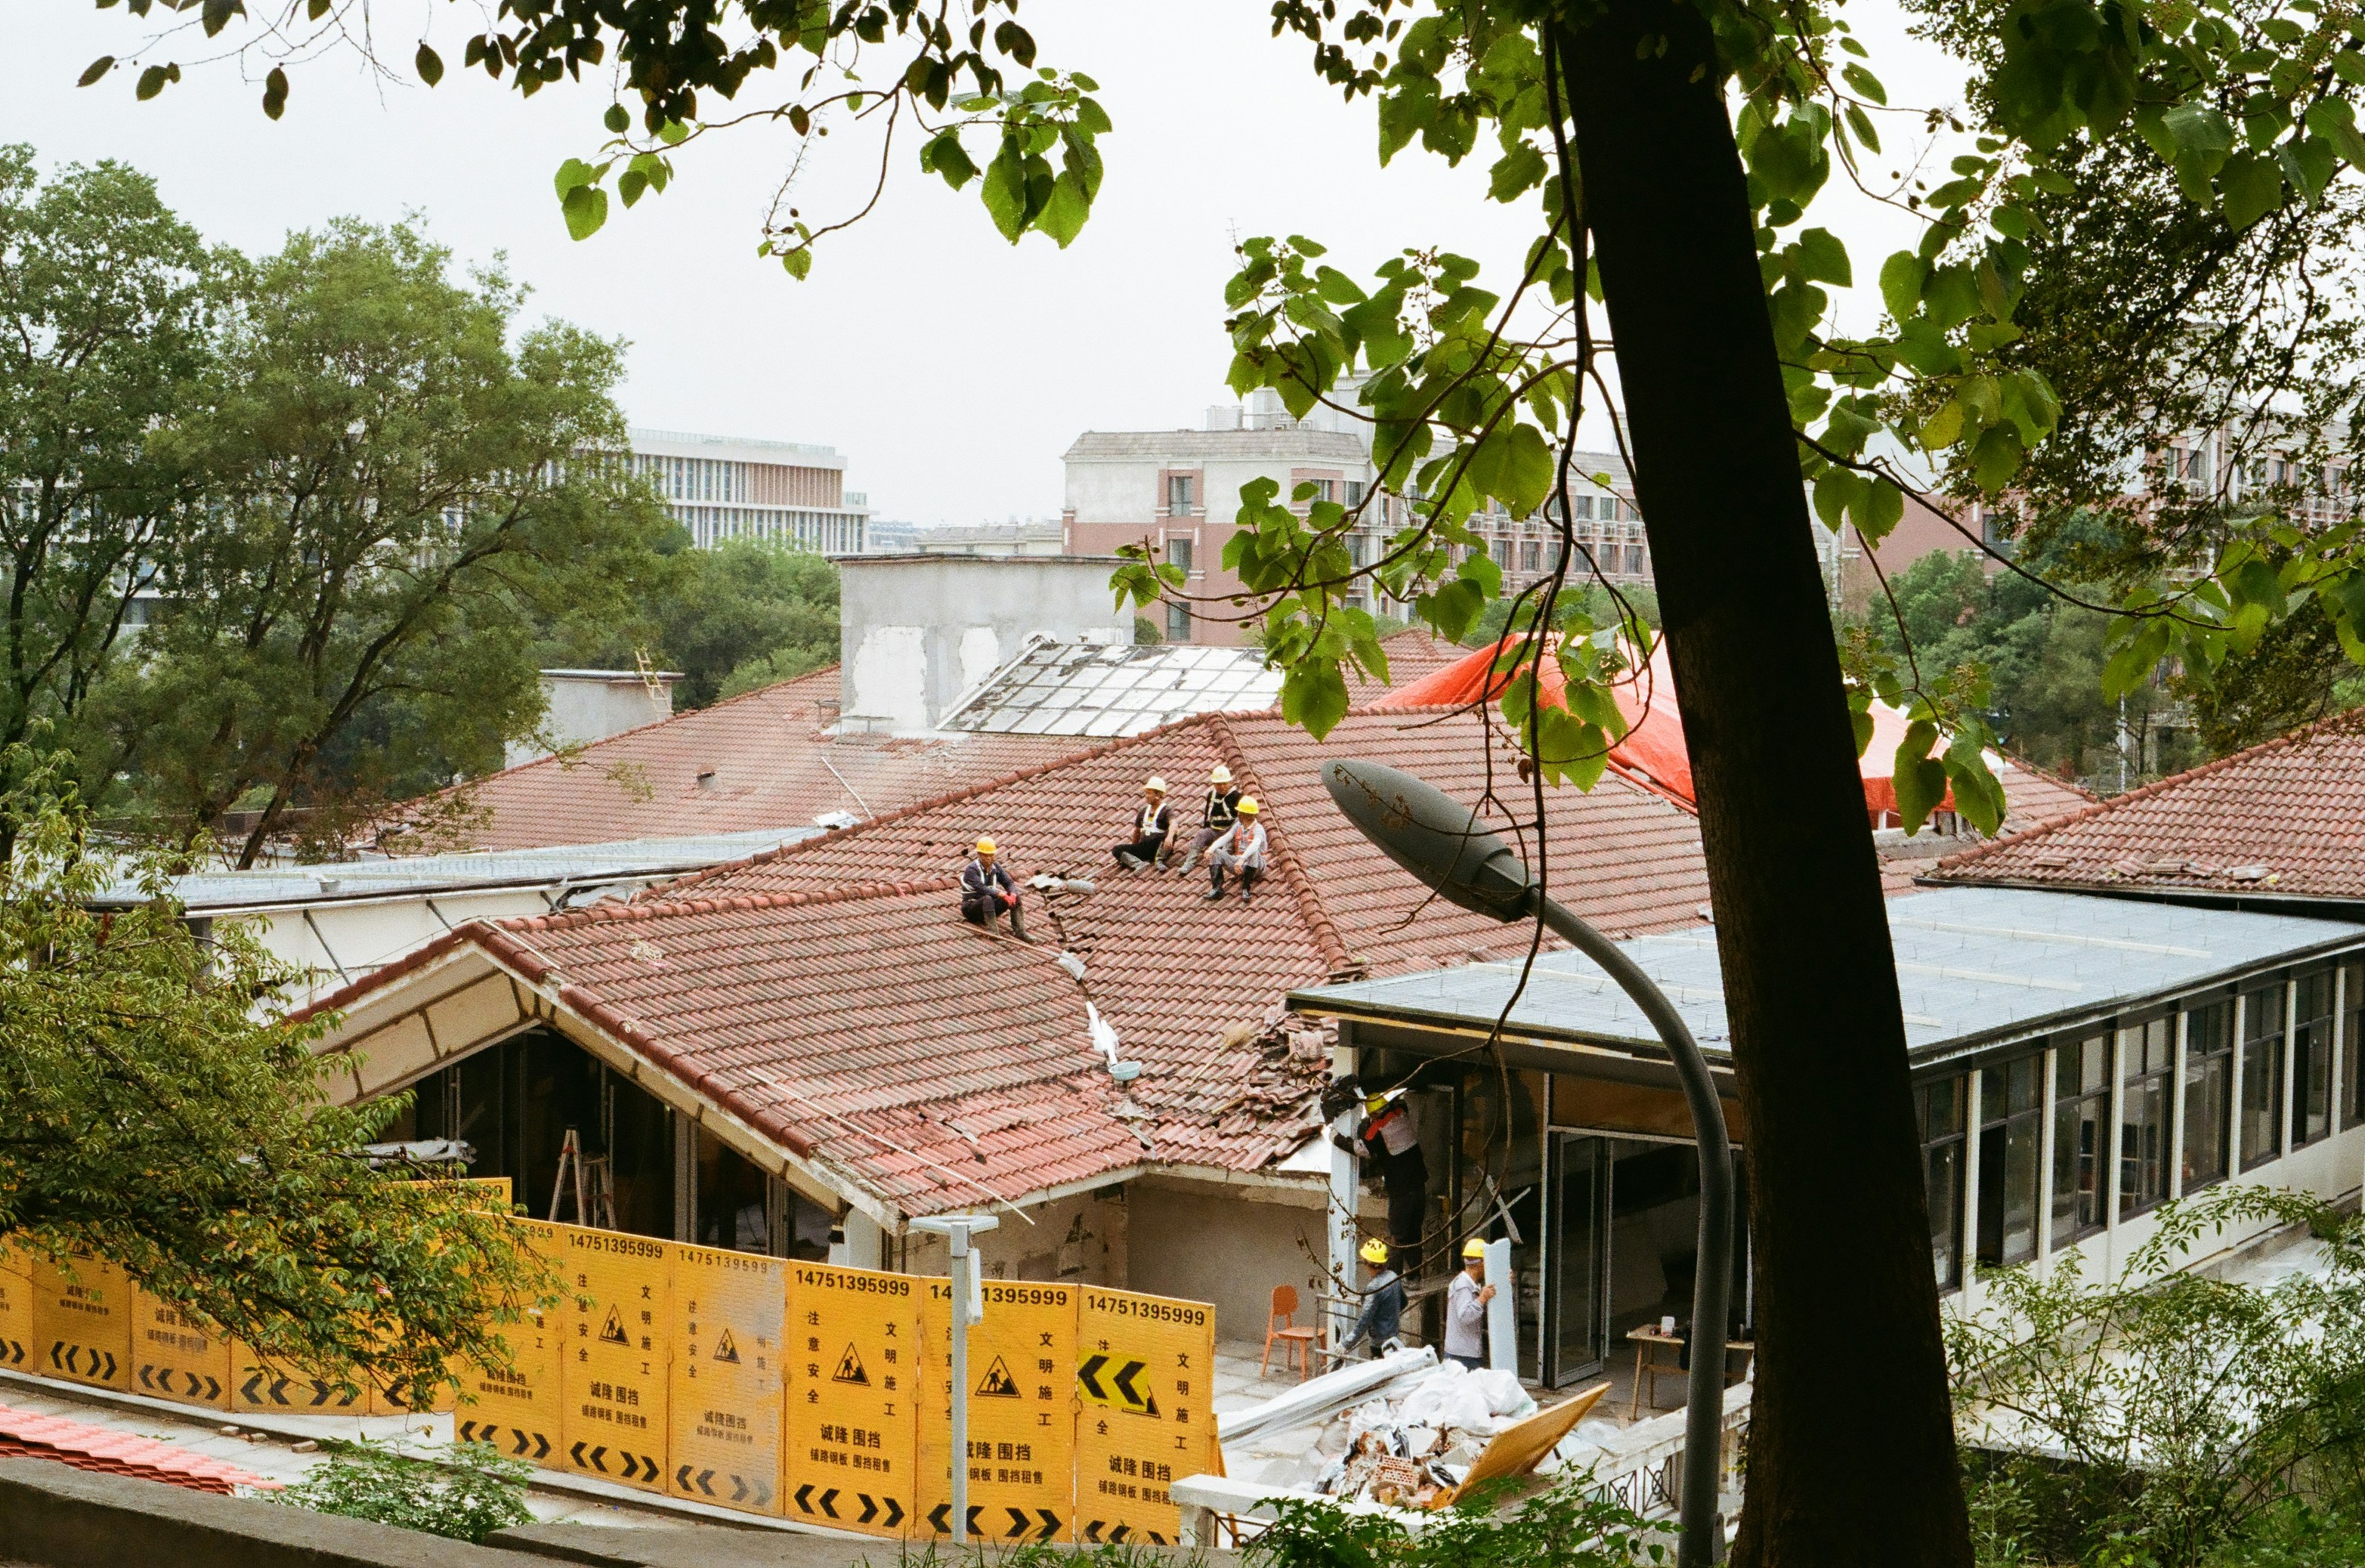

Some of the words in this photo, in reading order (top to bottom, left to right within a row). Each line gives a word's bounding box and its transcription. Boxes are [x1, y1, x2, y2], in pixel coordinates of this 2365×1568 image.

[569, 1233, 663, 1258] 14751395999
[680, 1249, 778, 1274] 1475139599
[796, 1270, 910, 1296] 14751395999
[930, 1285, 1067, 1306] 141395999
[1088, 1295, 1205, 1326] 14751395999
[577, 1274, 588, 1362] 注意安全
[641, 1285, 651, 1375] 文明施工
[808, 1312, 819, 1403] 注意安全
[883, 1322, 897, 1417] 文明施工
[1037, 1332, 1054, 1426] 文明施工
[1174, 1353, 1189, 1450] 文明施工
[1142, 1487, 1179, 1506] 围挡租
